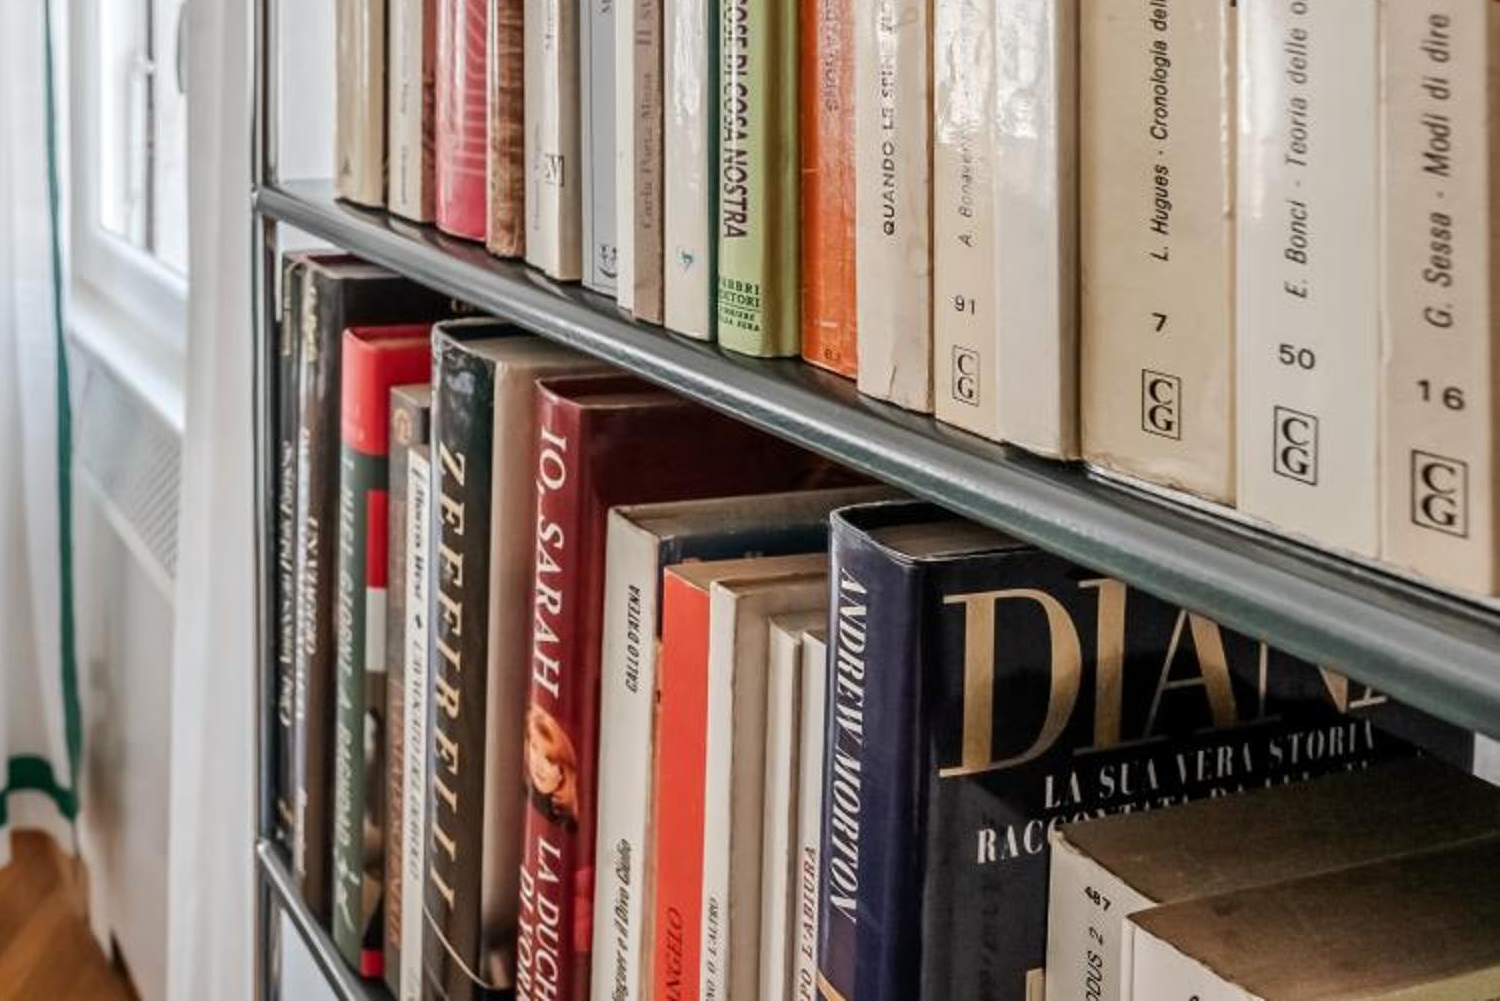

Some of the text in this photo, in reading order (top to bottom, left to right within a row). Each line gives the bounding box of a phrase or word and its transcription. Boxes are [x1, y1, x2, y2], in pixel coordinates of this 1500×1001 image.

[723, 53, 747, 77] DI
[1284, 28, 1309, 85] delle
[1419, 13, 1452, 63] dire
[723, 81, 747, 143] COSA
[1149, 40, 1171, 140] Cronologia
[1420, 75, 1452, 100] di
[1284, 97, 1308, 167] Teoria
[1420, 112, 1452, 178] Modi
[723, 147, 747, 238] NOSTRA
[882, 142, 897, 236] QUANDO
[1150, 164, 1173, 236] Hugues
[1150, 246, 1170, 262] L.
[1284, 199, 1309, 265] Bonci
[1284, 279, 1309, 299] E.
[1422, 302, 1454, 329] G.
[1151, 312, 1168, 332] 7
[1278, 343, 1316, 371] 50
[1416, 380, 1467, 411] 16
[339, 488, 355, 557] MIEI
[532, 425, 567, 698] IO, SARAH
[430, 440, 466, 912] ZEFFIRELLI
[625, 644, 640, 694] GALLO
[939, 578, 1388, 779] DIA
[829, 566, 868, 923] ANDREW MORTON
[1045, 717, 1378, 809] LA SUA VERA STORIA
[519, 864, 535, 914] DI
[537, 836, 561, 884] LA
[800, 846, 817, 960] L'ABIURA
